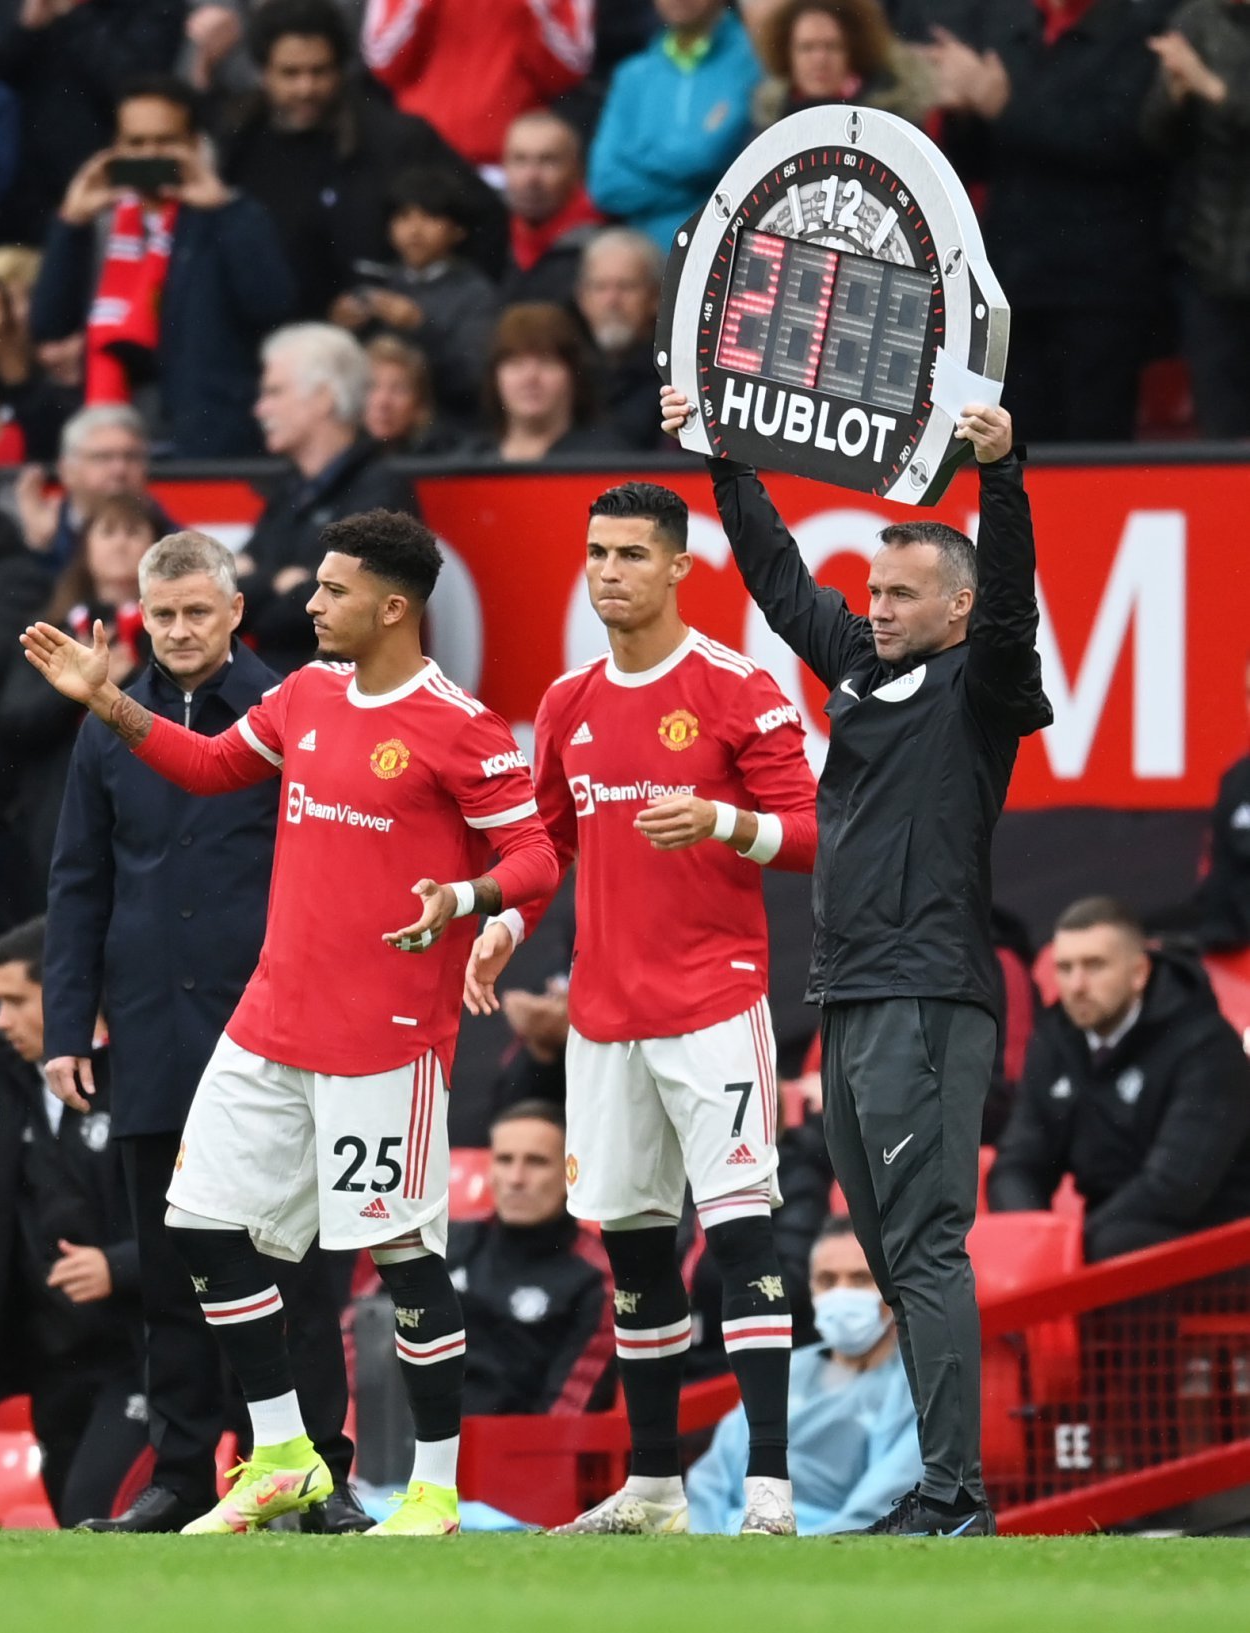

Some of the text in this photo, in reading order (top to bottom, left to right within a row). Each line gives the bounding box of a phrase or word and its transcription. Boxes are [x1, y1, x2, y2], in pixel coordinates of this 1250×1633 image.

[783, 162, 797, 178] 55
[843, 153, 857, 167] 60
[820, 174, 864, 229] 12
[897, 189, 910, 207] 05
[703, 398, 714, 417] 40
[720, 377, 897, 463] HUBLOT
[899, 445, 911, 464] 20
[591, 780, 696, 802] TeamViewer
[304, 796, 394, 832] TeamViewer
[724, 1081, 754, 1138] 7
[332, 1135, 403, 1193] 25
[359, 1210, 390, 1219] adidas
